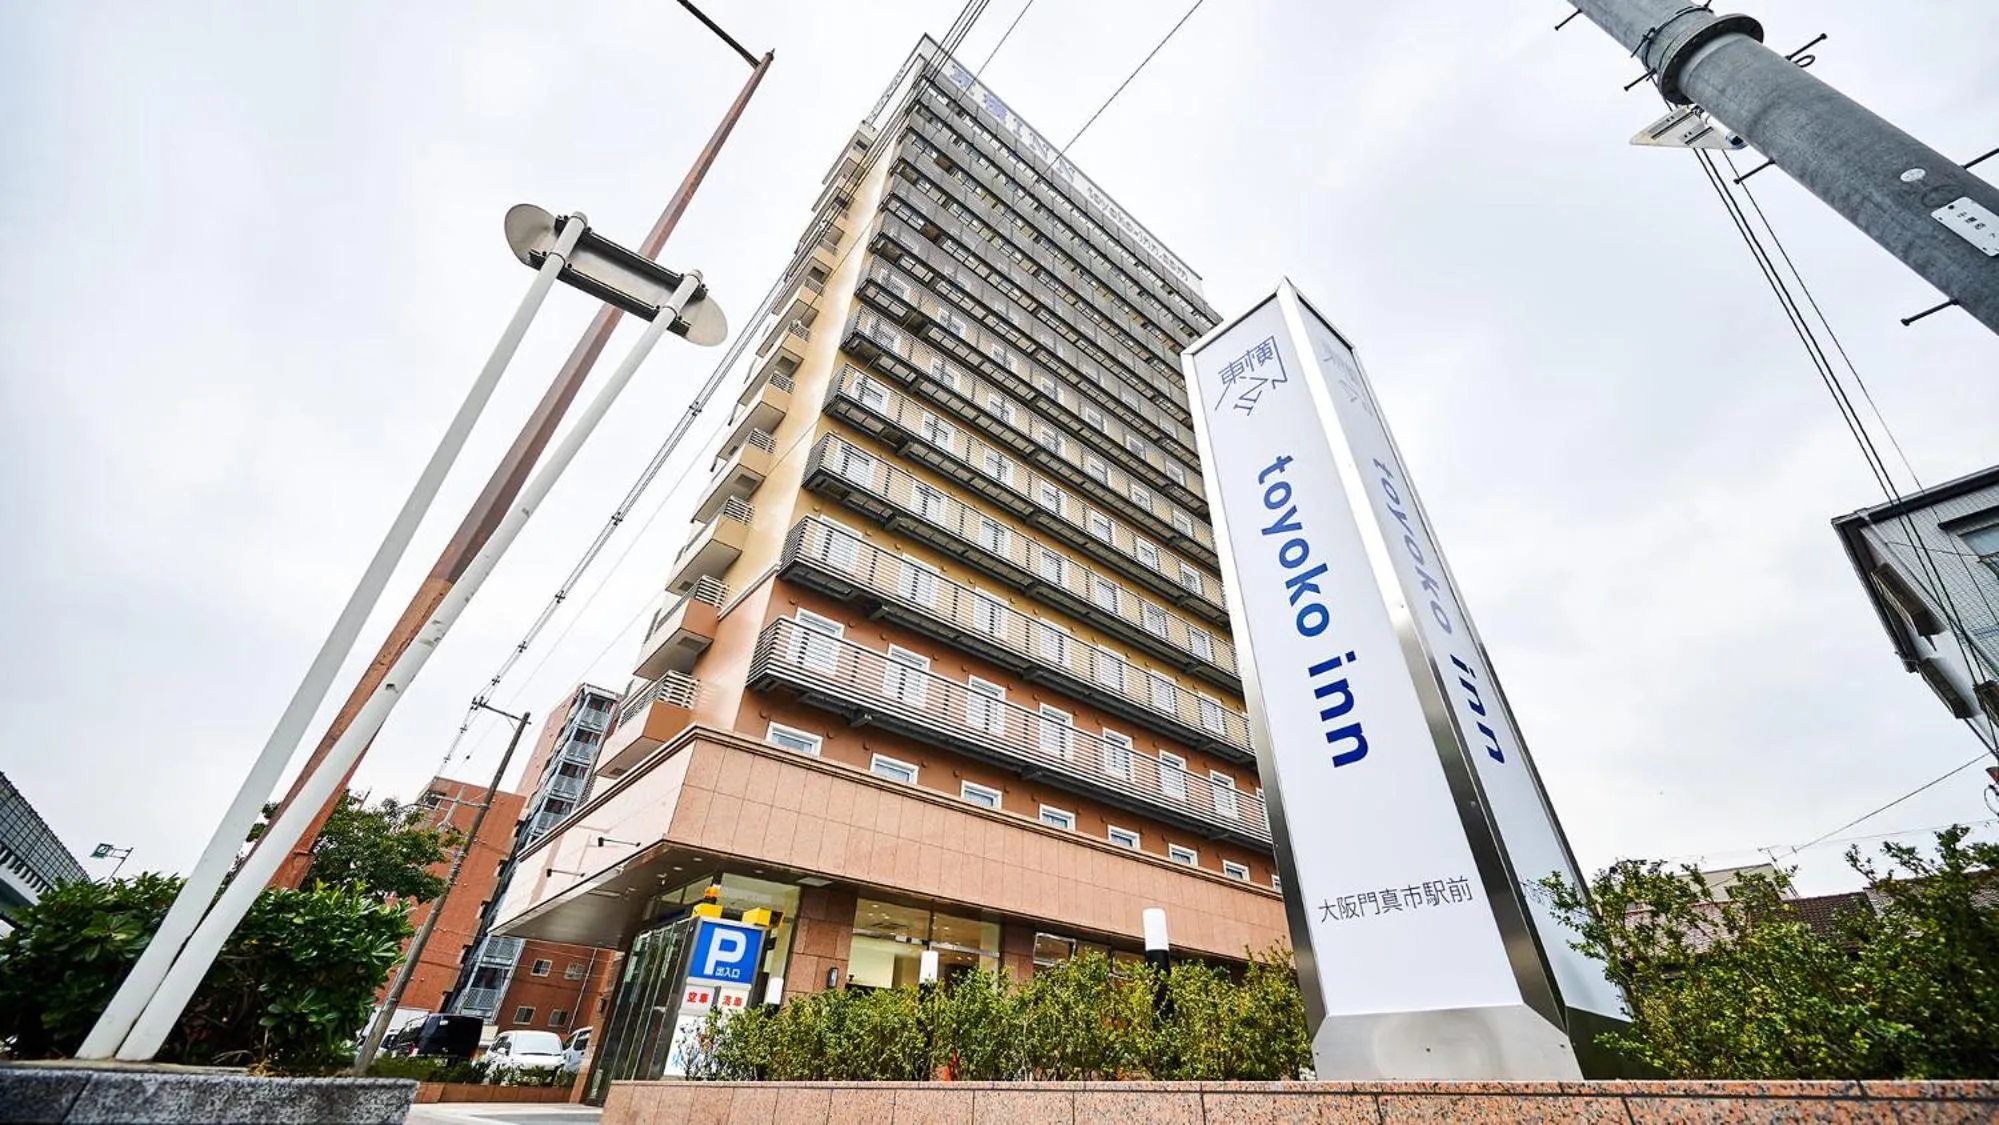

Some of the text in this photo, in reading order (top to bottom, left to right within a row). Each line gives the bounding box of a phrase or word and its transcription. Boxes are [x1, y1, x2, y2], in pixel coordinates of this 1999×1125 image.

[1258, 455, 1369, 768] toyoko inn
[1373, 457, 1505, 764] toyoko inn
[1318, 875, 1473, 923] 大阪門真市駅前
[703, 927, 747, 975] P
[715, 966, 740, 978] 出入口
[687, 991, 708, 1004] 空車
